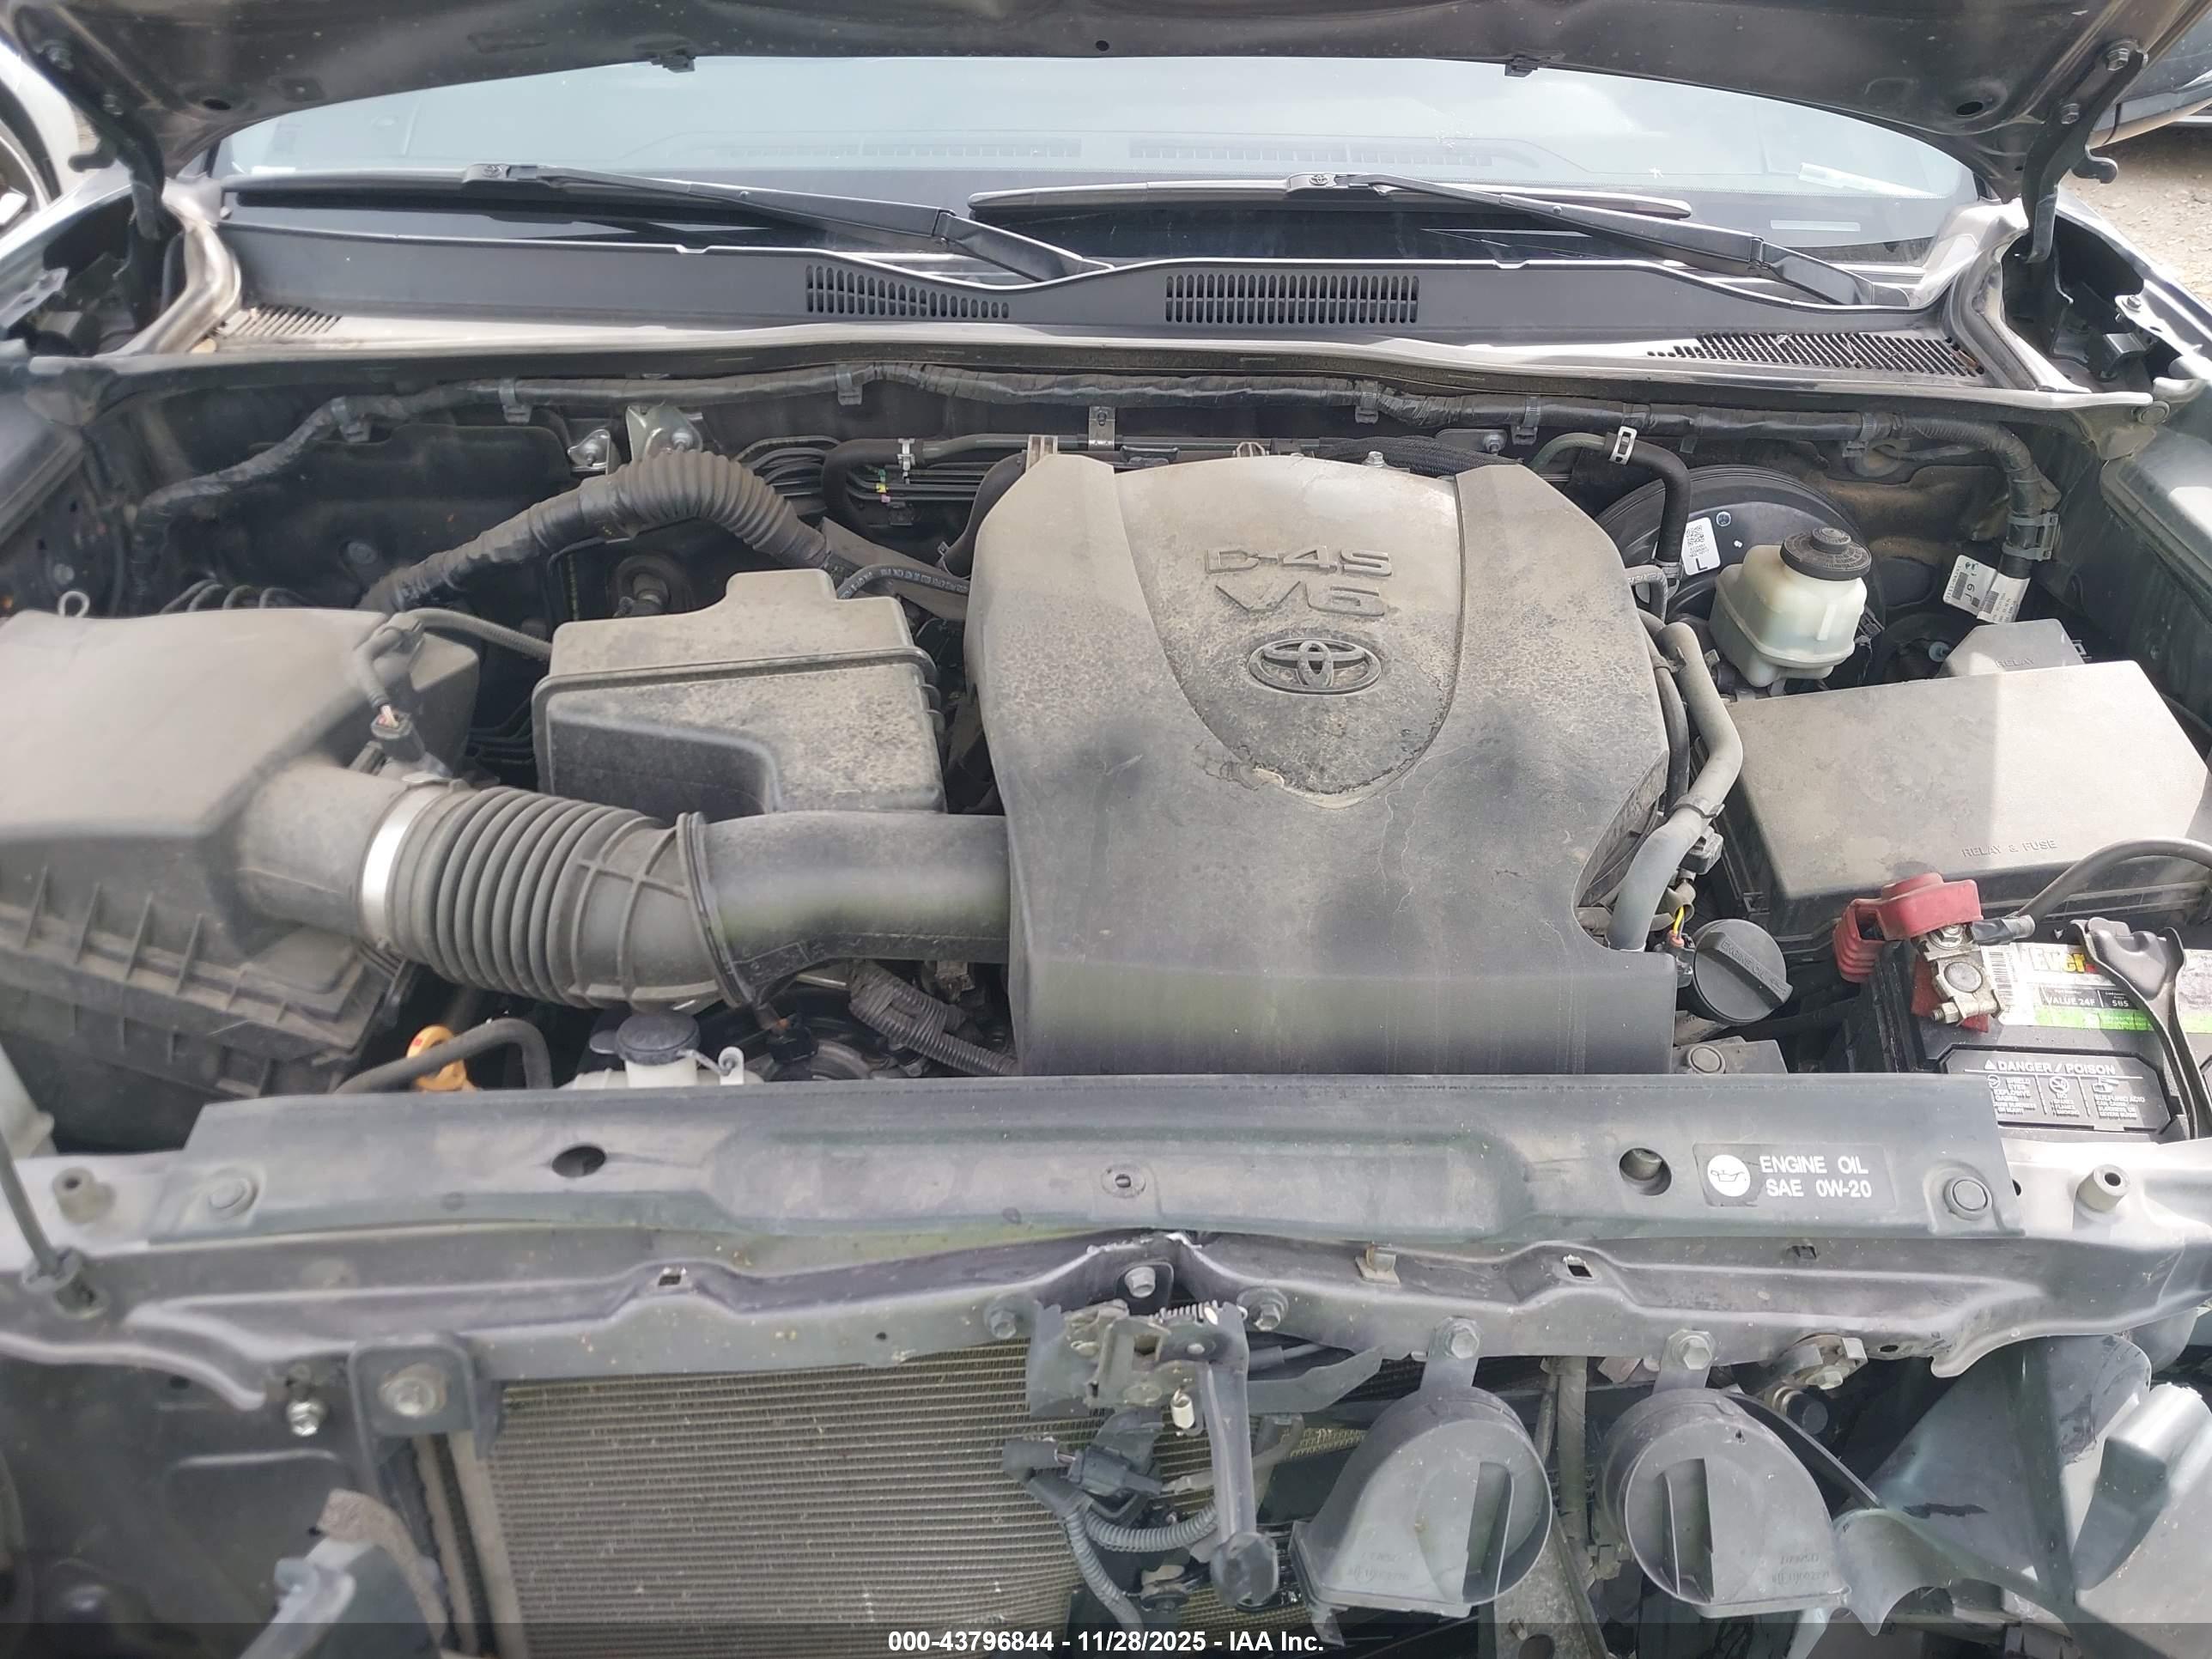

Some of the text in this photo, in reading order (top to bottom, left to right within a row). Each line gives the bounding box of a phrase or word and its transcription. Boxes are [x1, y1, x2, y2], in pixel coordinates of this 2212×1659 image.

[1205, 545, 1393, 577] D-4S
[1695, 557, 1709, 572] L
[1214, 581, 1389, 617] V6
[1995, 658, 2034, 668] RELAY
[1961, 839, 2058, 857] RELAY & FUSE
[1720, 939, 1766, 980] ENGINE OIL
[2045, 996, 2077, 1006] VALUE
[1997, 1060, 2052, 1073] DANGER
[2066, 1063, 2116, 1074] POISON
[1759, 1155, 1869, 1175] ENGINE OIL
[1765, 1179, 1873, 1198] SAE 0W-20
